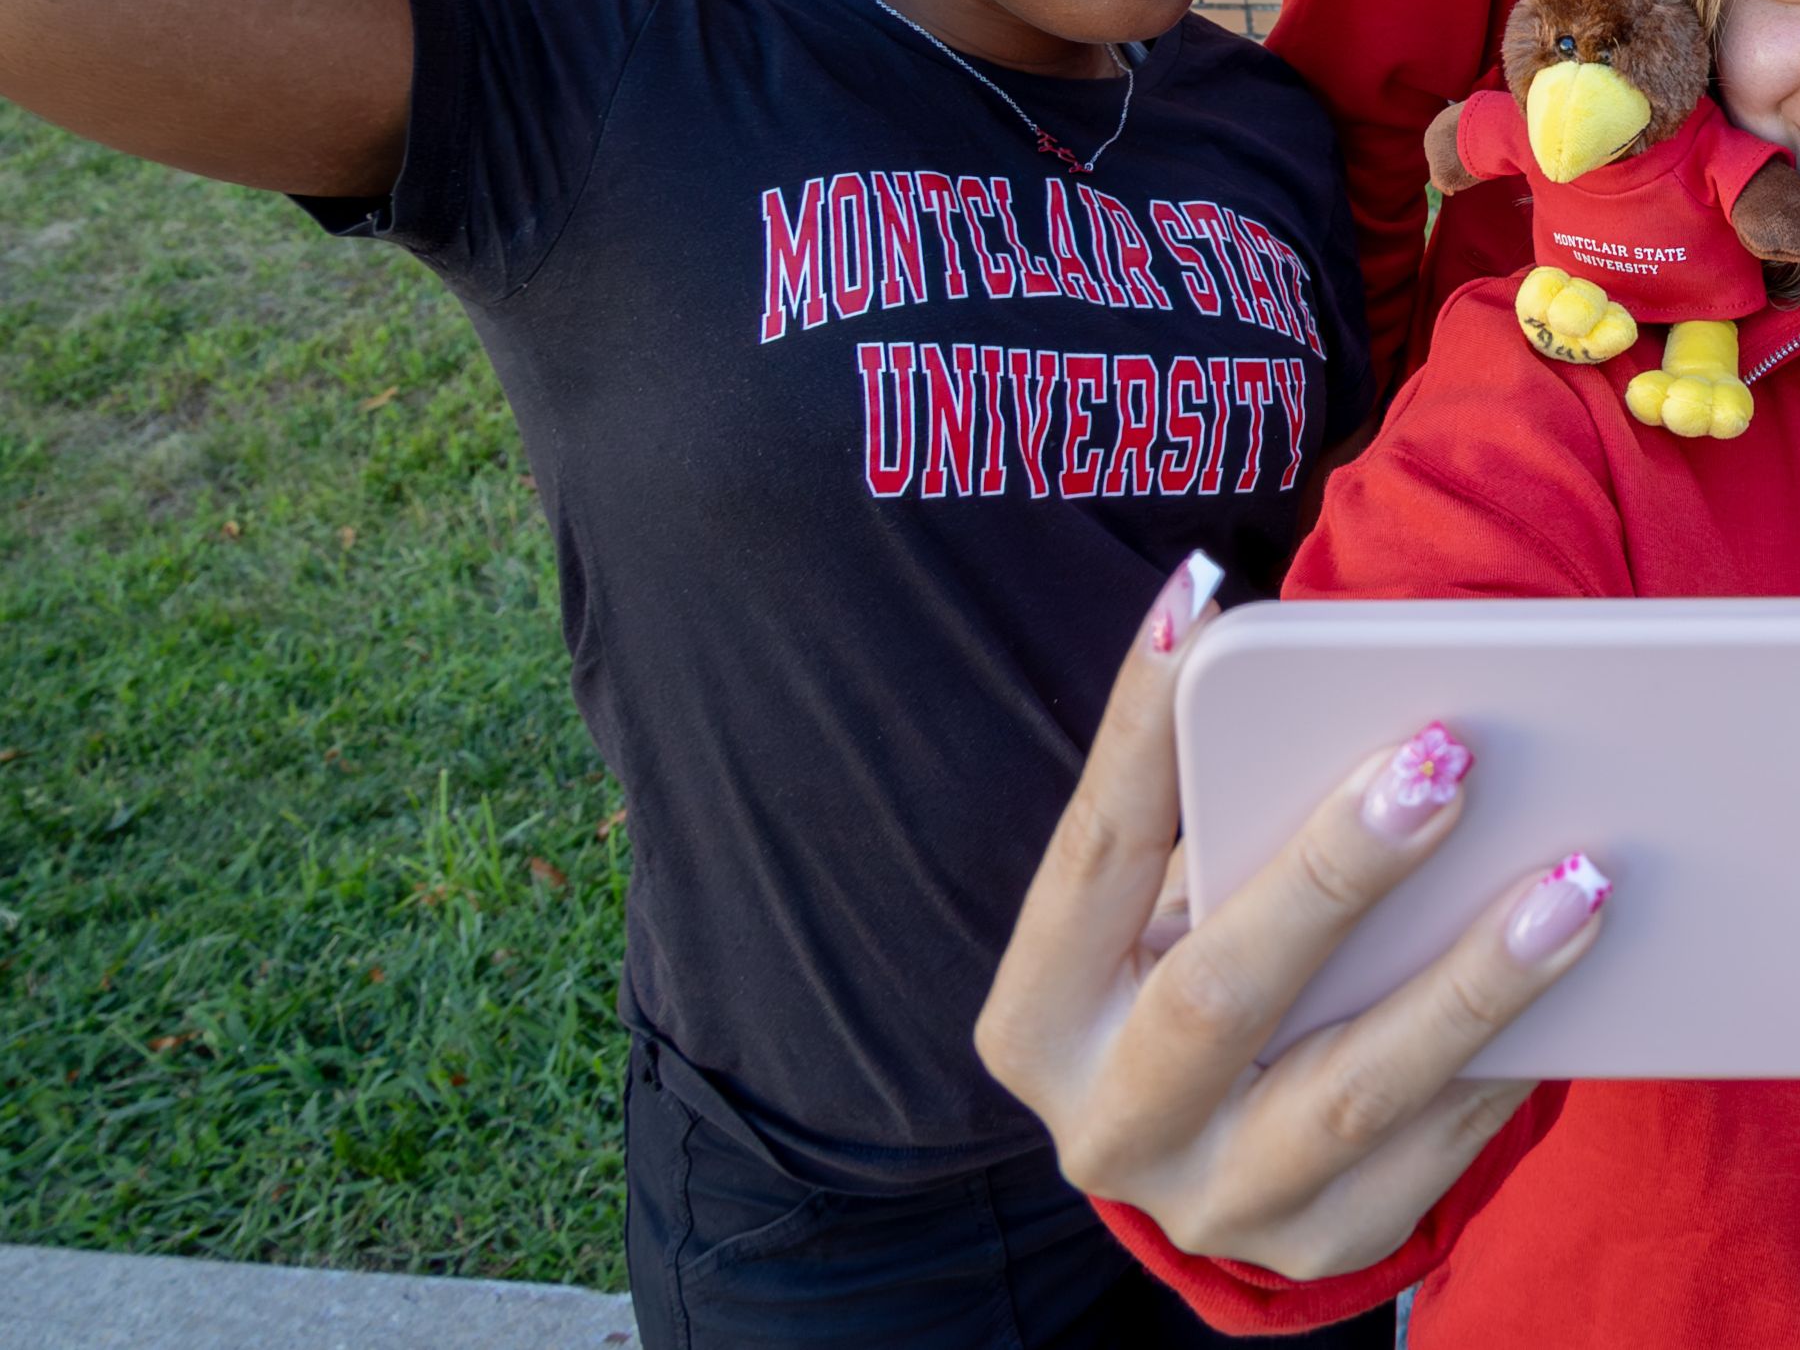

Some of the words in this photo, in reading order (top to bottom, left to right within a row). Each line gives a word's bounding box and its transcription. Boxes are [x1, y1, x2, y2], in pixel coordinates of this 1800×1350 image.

[760, 170, 1174, 345] MONTCLAIR
[1150, 199, 1328, 361] STATE
[1552, 232, 1630, 258] MONTCLAIR
[1634, 246, 1687, 262] STATE
[1573, 250, 1659, 275] UNIVERSITY
[856, 341, 1307, 500] UNIVERSITY
